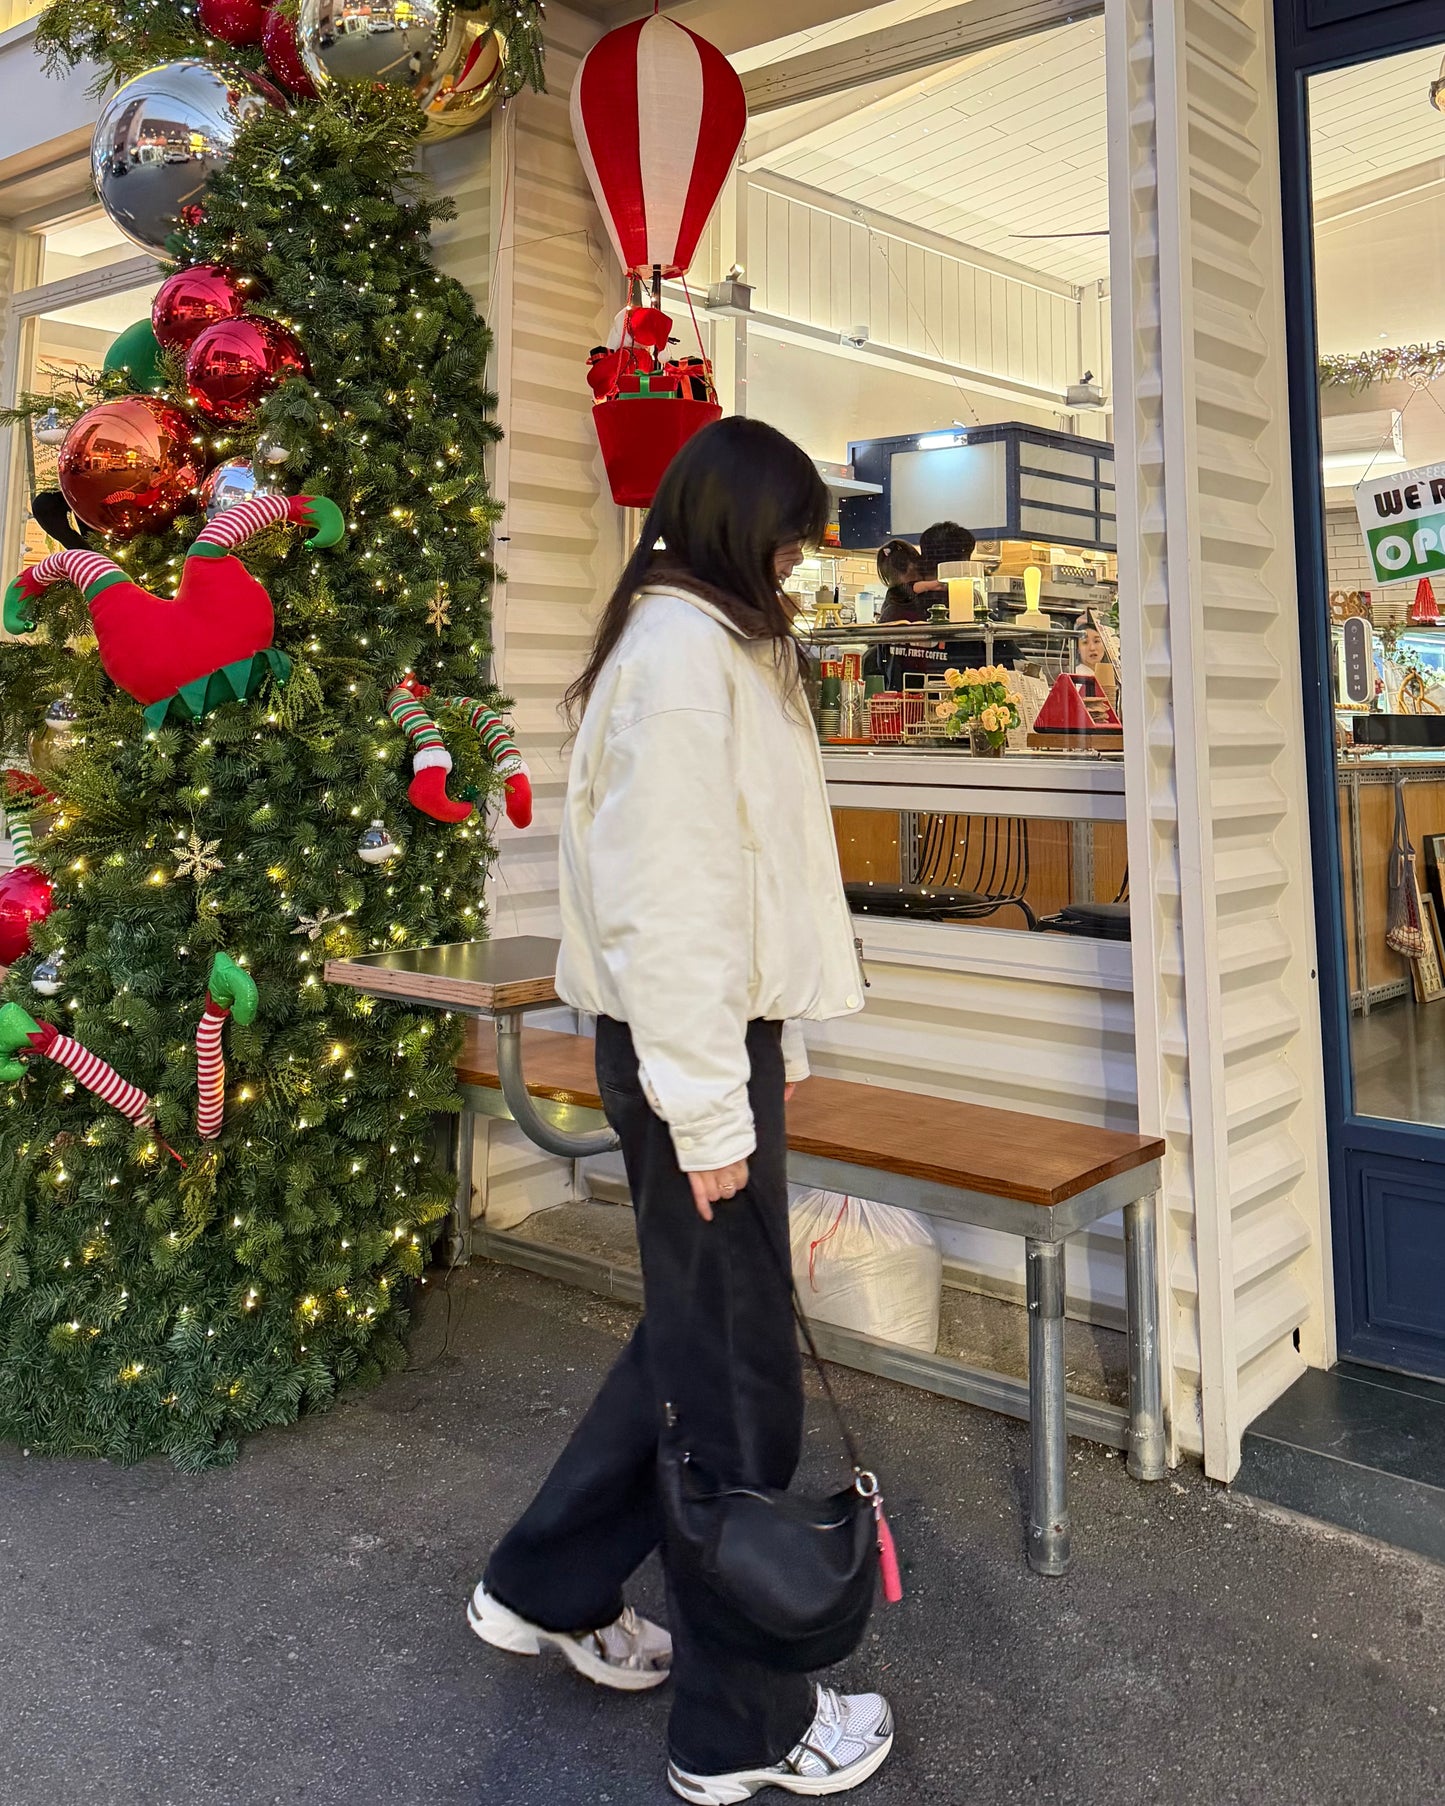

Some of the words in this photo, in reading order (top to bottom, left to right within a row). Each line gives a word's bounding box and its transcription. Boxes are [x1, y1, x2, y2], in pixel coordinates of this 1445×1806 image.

[908, 648, 925, 658] FIRST
[925, 651, 948, 661] COFFEE
[1352, 654, 1361, 690] PUSH
